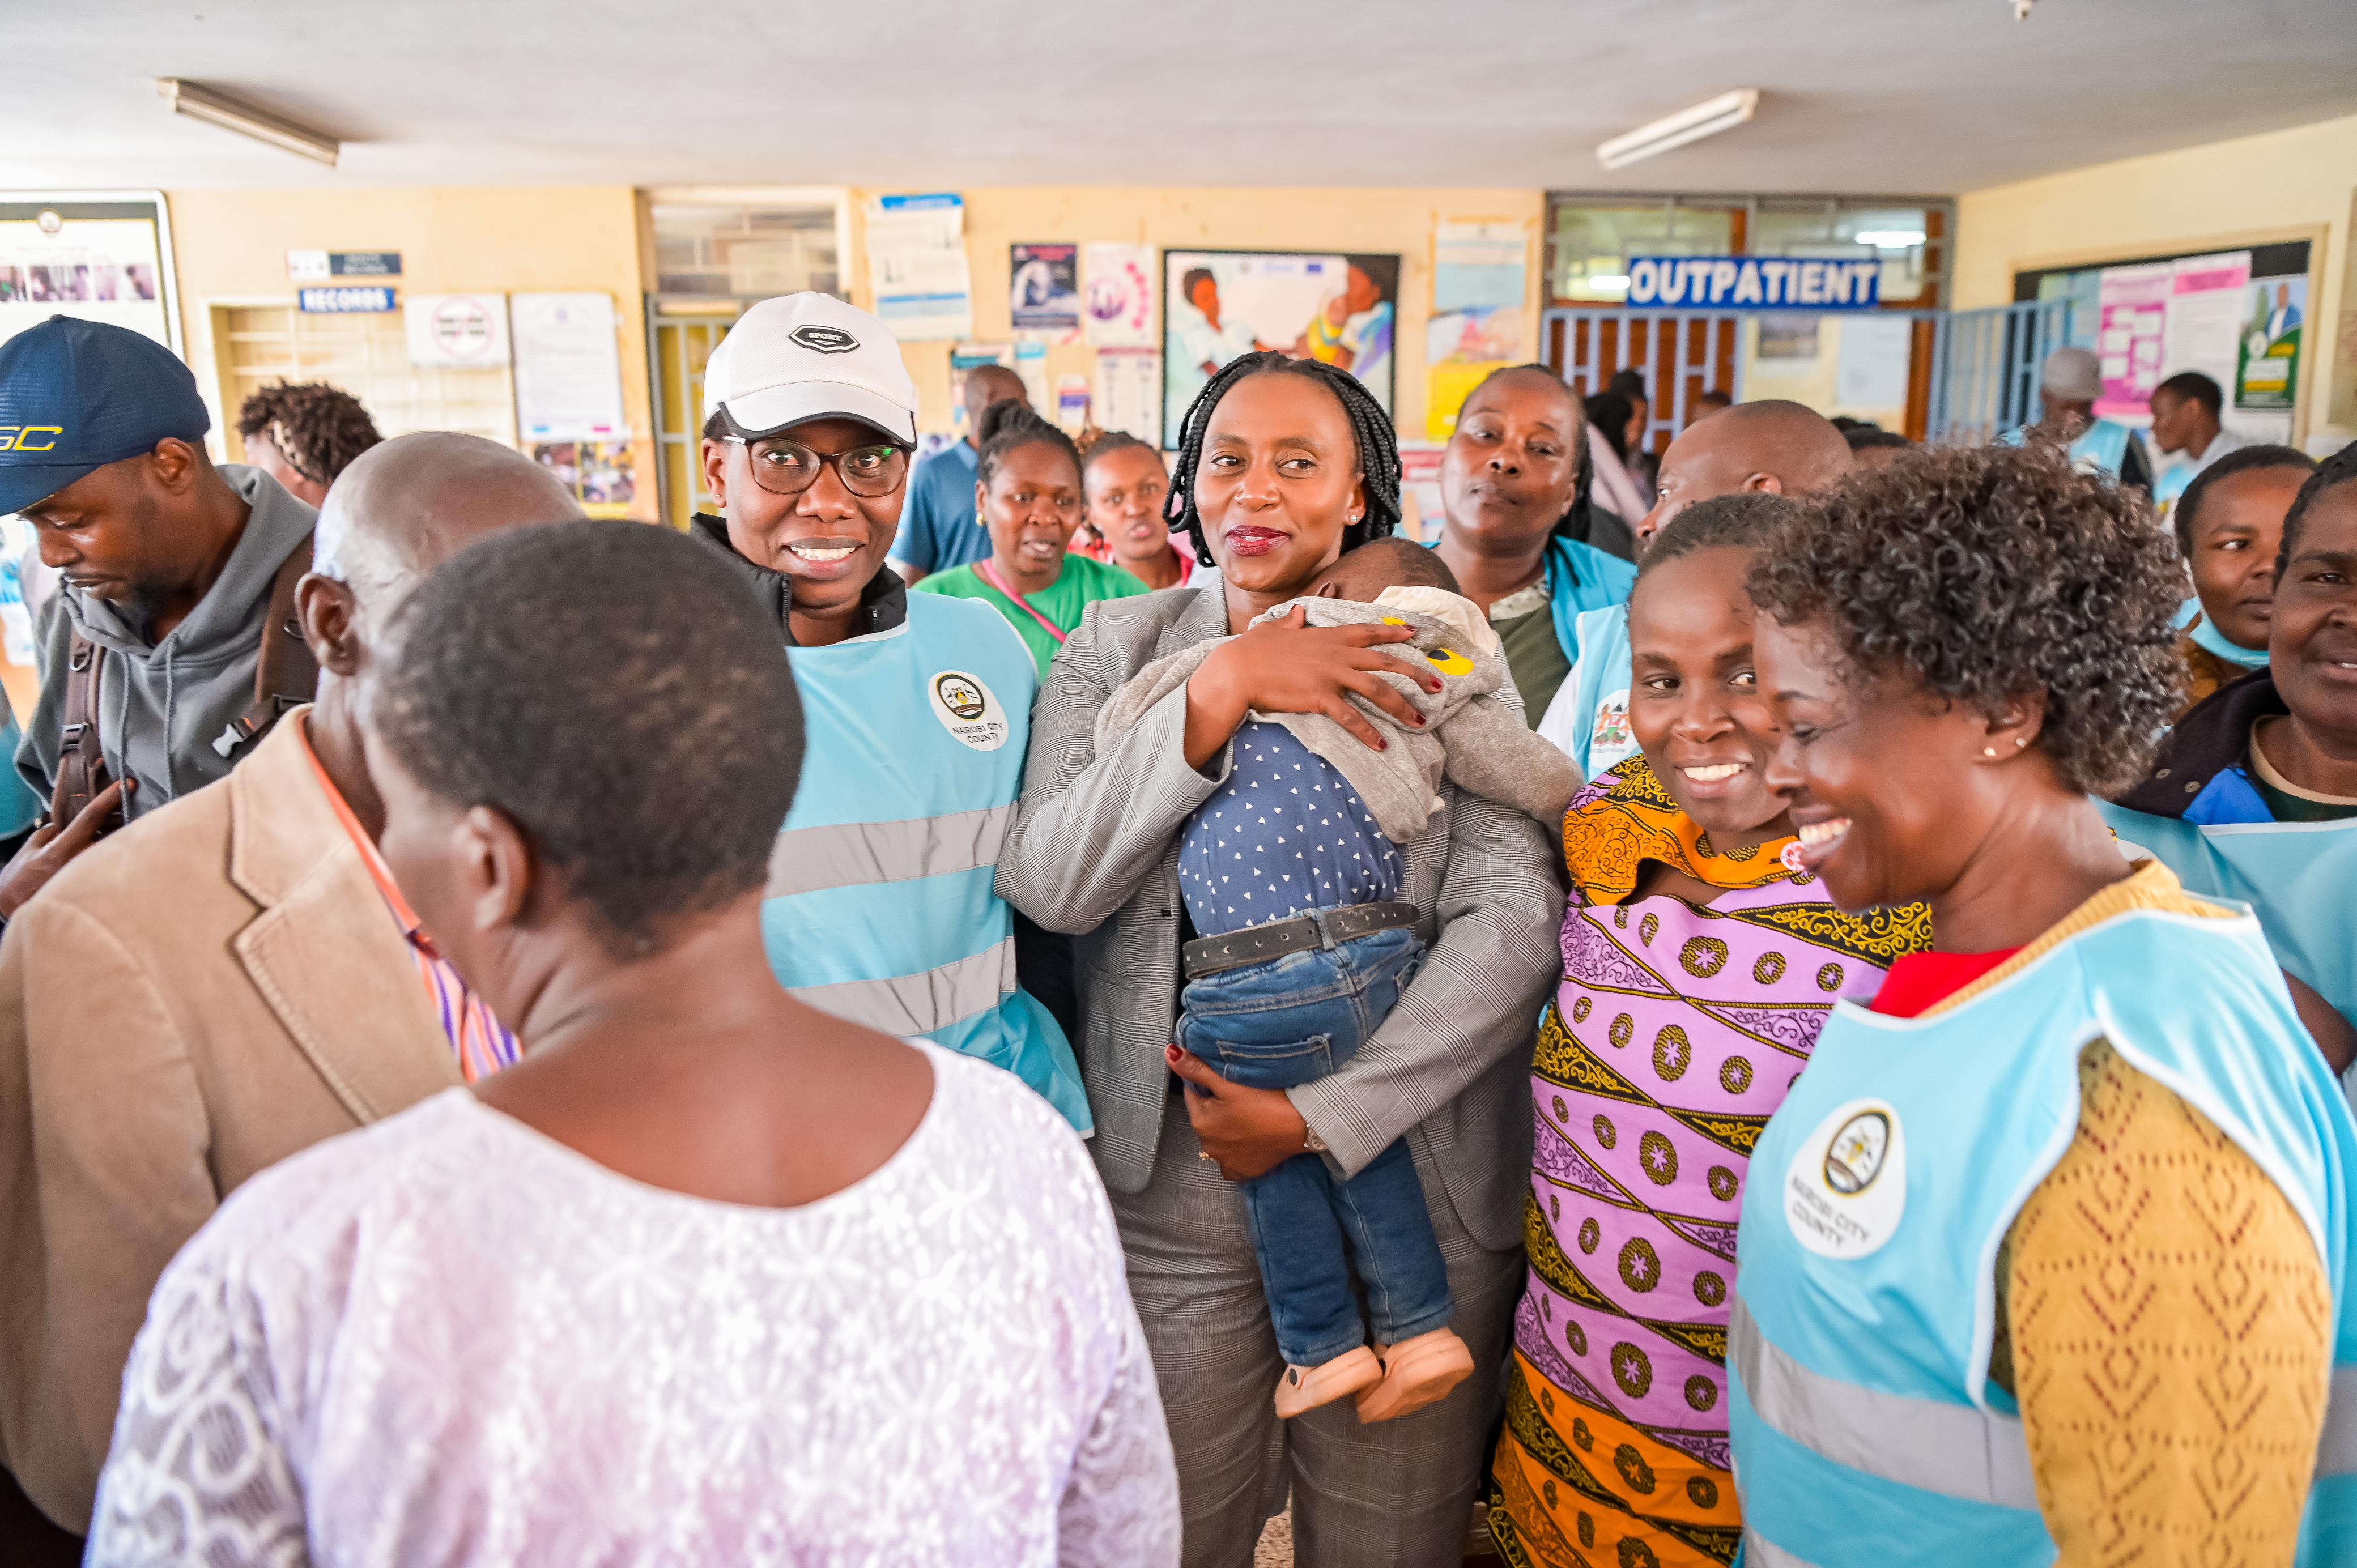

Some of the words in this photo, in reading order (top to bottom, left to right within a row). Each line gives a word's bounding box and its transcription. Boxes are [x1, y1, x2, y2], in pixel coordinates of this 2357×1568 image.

[1630, 260, 1877, 304] OUTPATIENT
[304, 288, 388, 311] RECORDS
[808, 332, 843, 342] SPORT
[952, 725, 986, 735] NAIROBI
[1791, 1175, 1833, 1218] NAIROBI
[1834, 1212, 1870, 1243] CITY
[1792, 1200, 1845, 1247] COUNTY
